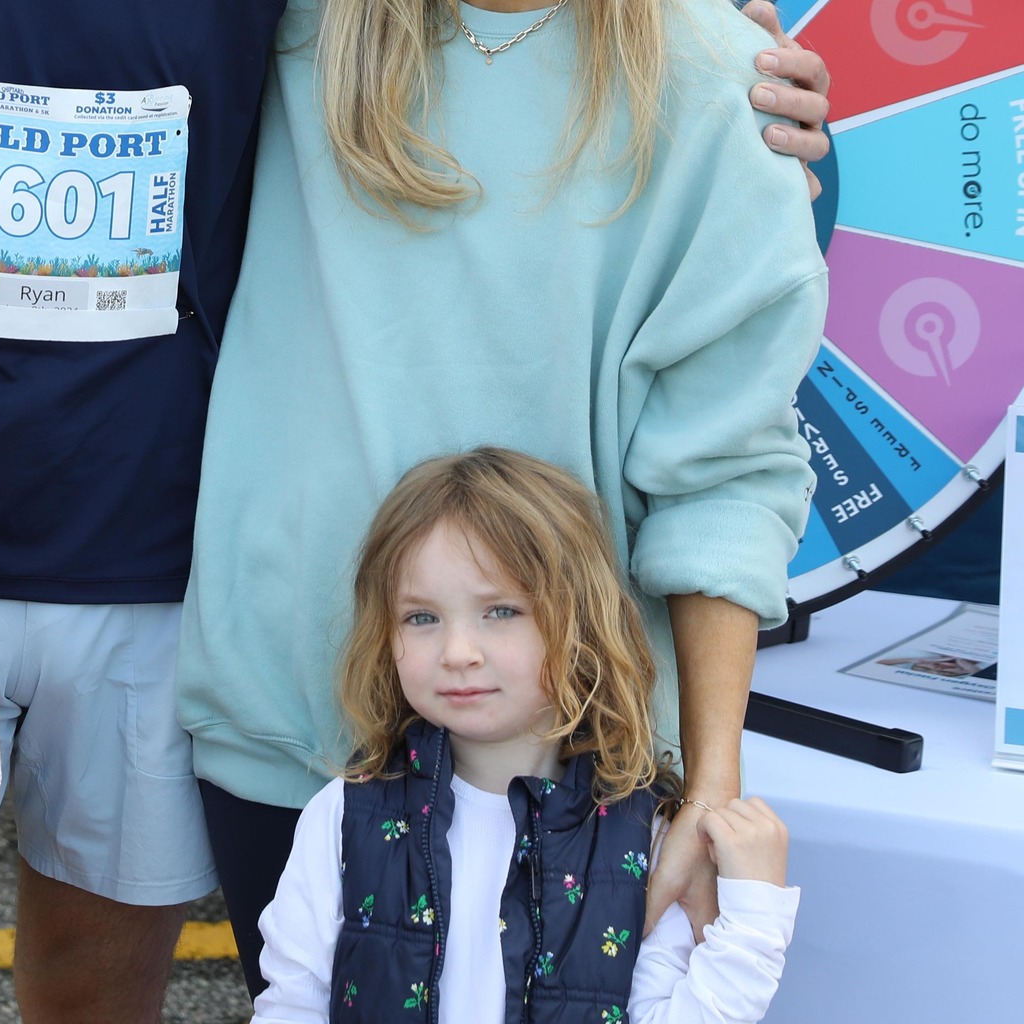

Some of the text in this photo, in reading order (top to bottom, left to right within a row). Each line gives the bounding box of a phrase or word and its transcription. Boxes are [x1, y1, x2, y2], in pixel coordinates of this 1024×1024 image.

[9, 92, 51, 106] PORT
[76, 105, 133, 115] DONATION
[94, 91, 116, 105] $3
[60, 129, 167, 158] PORT
[960, 103, 987, 238] do more.
[149, 175, 169, 234] HALF
[165, 172, 177, 233] MARATHON
[20, 285, 66, 306] Ryan
[831, 482, 884, 524] FREE
